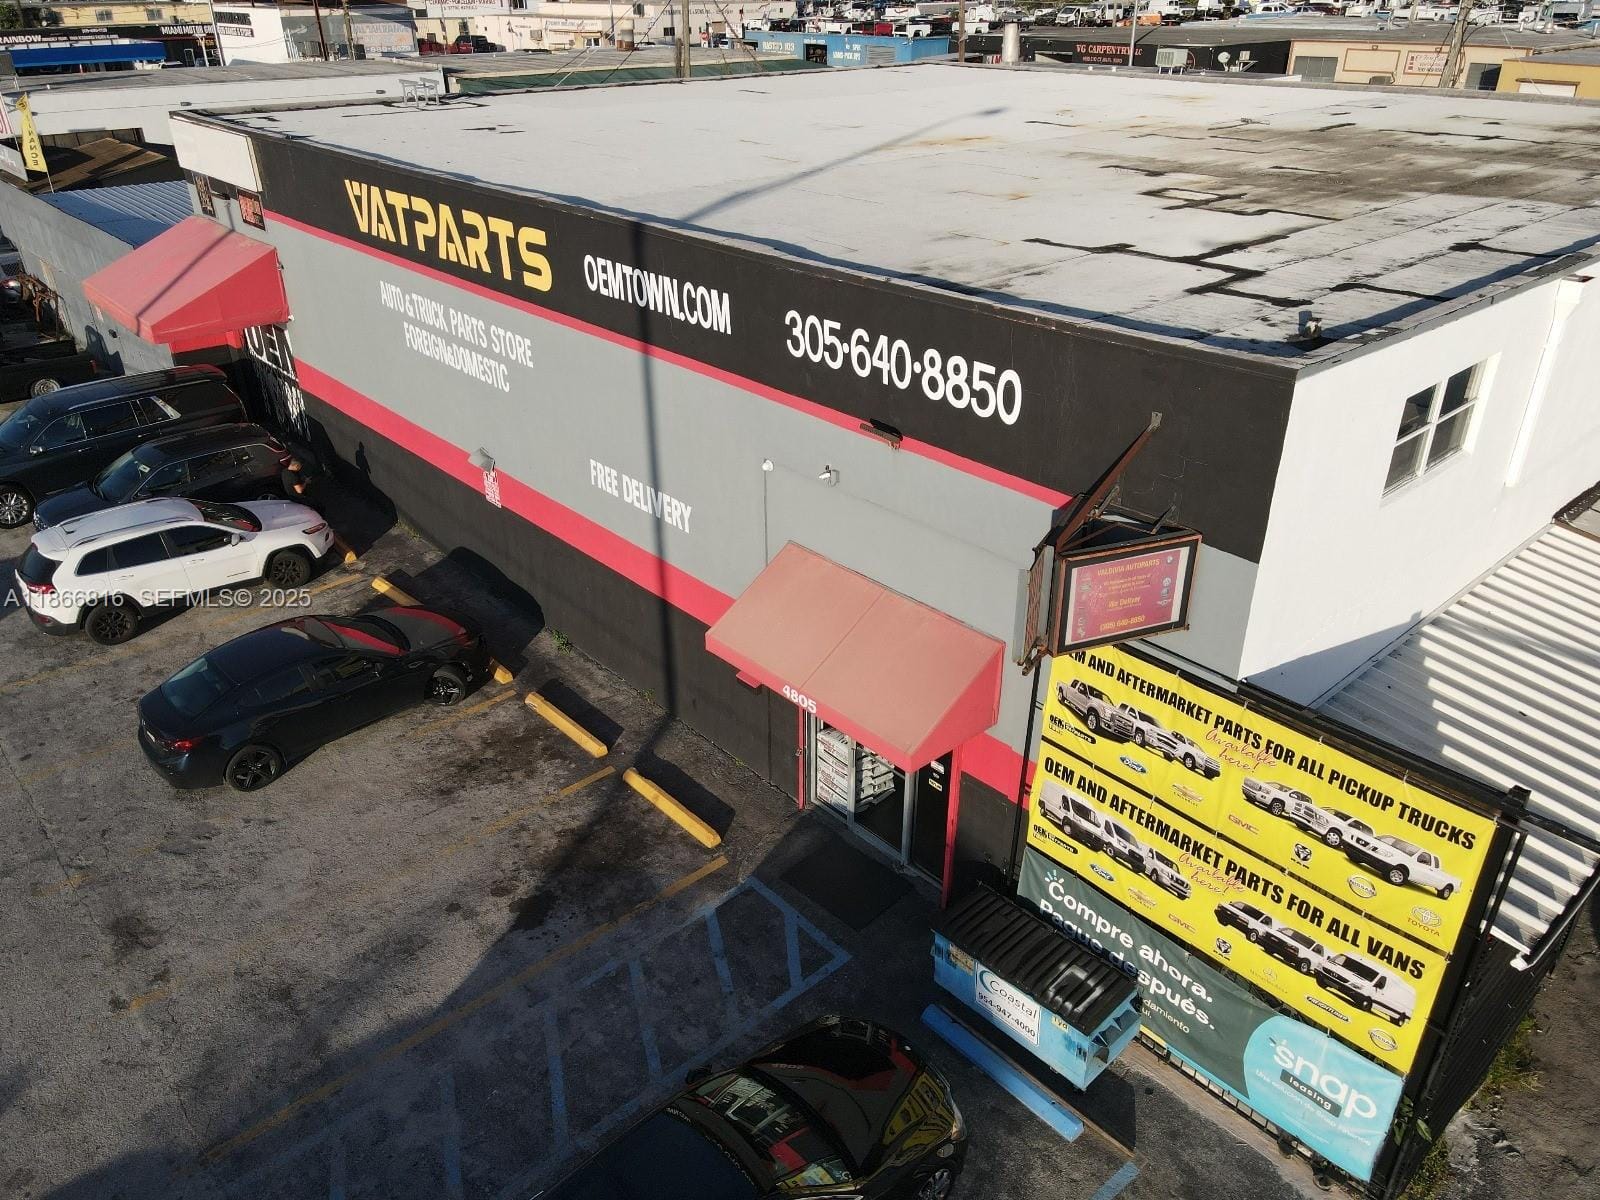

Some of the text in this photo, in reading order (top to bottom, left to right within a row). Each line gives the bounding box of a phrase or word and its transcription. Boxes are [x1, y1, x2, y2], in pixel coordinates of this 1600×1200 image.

[161, 26, 183, 34] MIAMI
[1076, 44, 1086, 53] VG
[1088, 45, 1132, 56] CARPENTRY
[344, 179, 553, 292] VATPARTS
[380, 280, 404, 312] AUTO
[411, 292, 448, 332] TRUCK
[450, 308, 488, 348] PARTS
[491, 325, 534, 368] STORE
[583, 254, 732, 335] OEMTOWN.COM
[590, 458, 692, 534] FREE DELIVERY
[1087, 654, 1115, 678] AND
[1117, 668, 1213, 725] AFTERMARKET
[1213, 715, 1262, 749] PARTS
[1265, 738, 1296, 766] FOR
[1297, 755, 1325, 780] ALL
[1328, 768, 1395, 812] PICKUP
[1397, 801, 1477, 850] TRUCKS
[1044, 756, 1076, 785] OEM
[1076, 777, 1108, 804] AND
[1109, 791, 1224, 869] AFTERMARKET
[1224, 859, 1284, 905] PARTS
[1286, 893, 1325, 928] FOR
[1326, 917, 1360, 948] ALL
[1366, 935, 1426, 980] VANS
[1048, 881, 1134, 949] Compre
[1139, 944, 1213, 1002] ahora.
[1408, 917, 1440, 937] TOYOTA
[989, 980, 1037, 1020] Coastal
[1142, 998, 1190, 1034] damiento
[1273, 1044, 1377, 1119] snap
